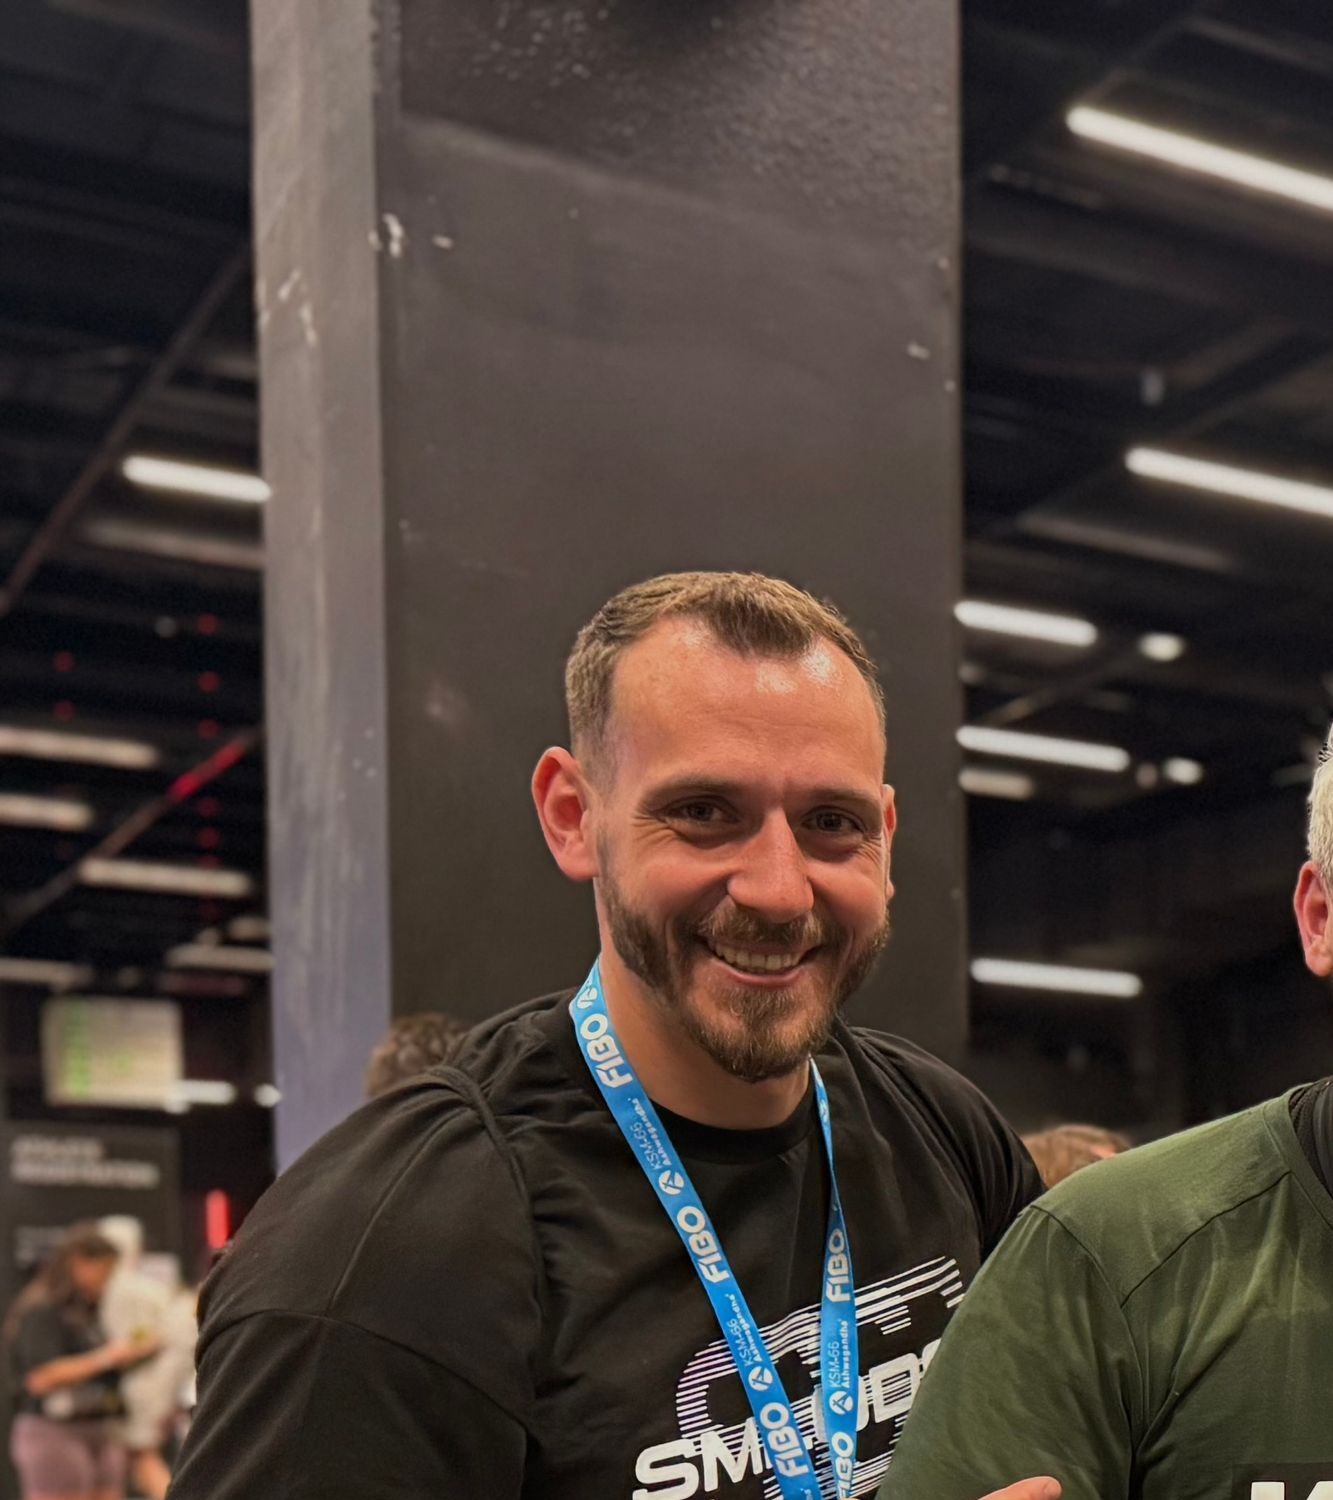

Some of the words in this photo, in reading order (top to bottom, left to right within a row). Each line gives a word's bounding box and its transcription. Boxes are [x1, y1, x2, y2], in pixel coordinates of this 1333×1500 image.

[580, 1013, 633, 1088] FIBO
[677, 1206, 730, 1284] FIBO
[826, 1228, 851, 1303] FIBO
[828, 1341, 840, 1389] KSM-66
[760, 1402, 809, 1477] FIBO
